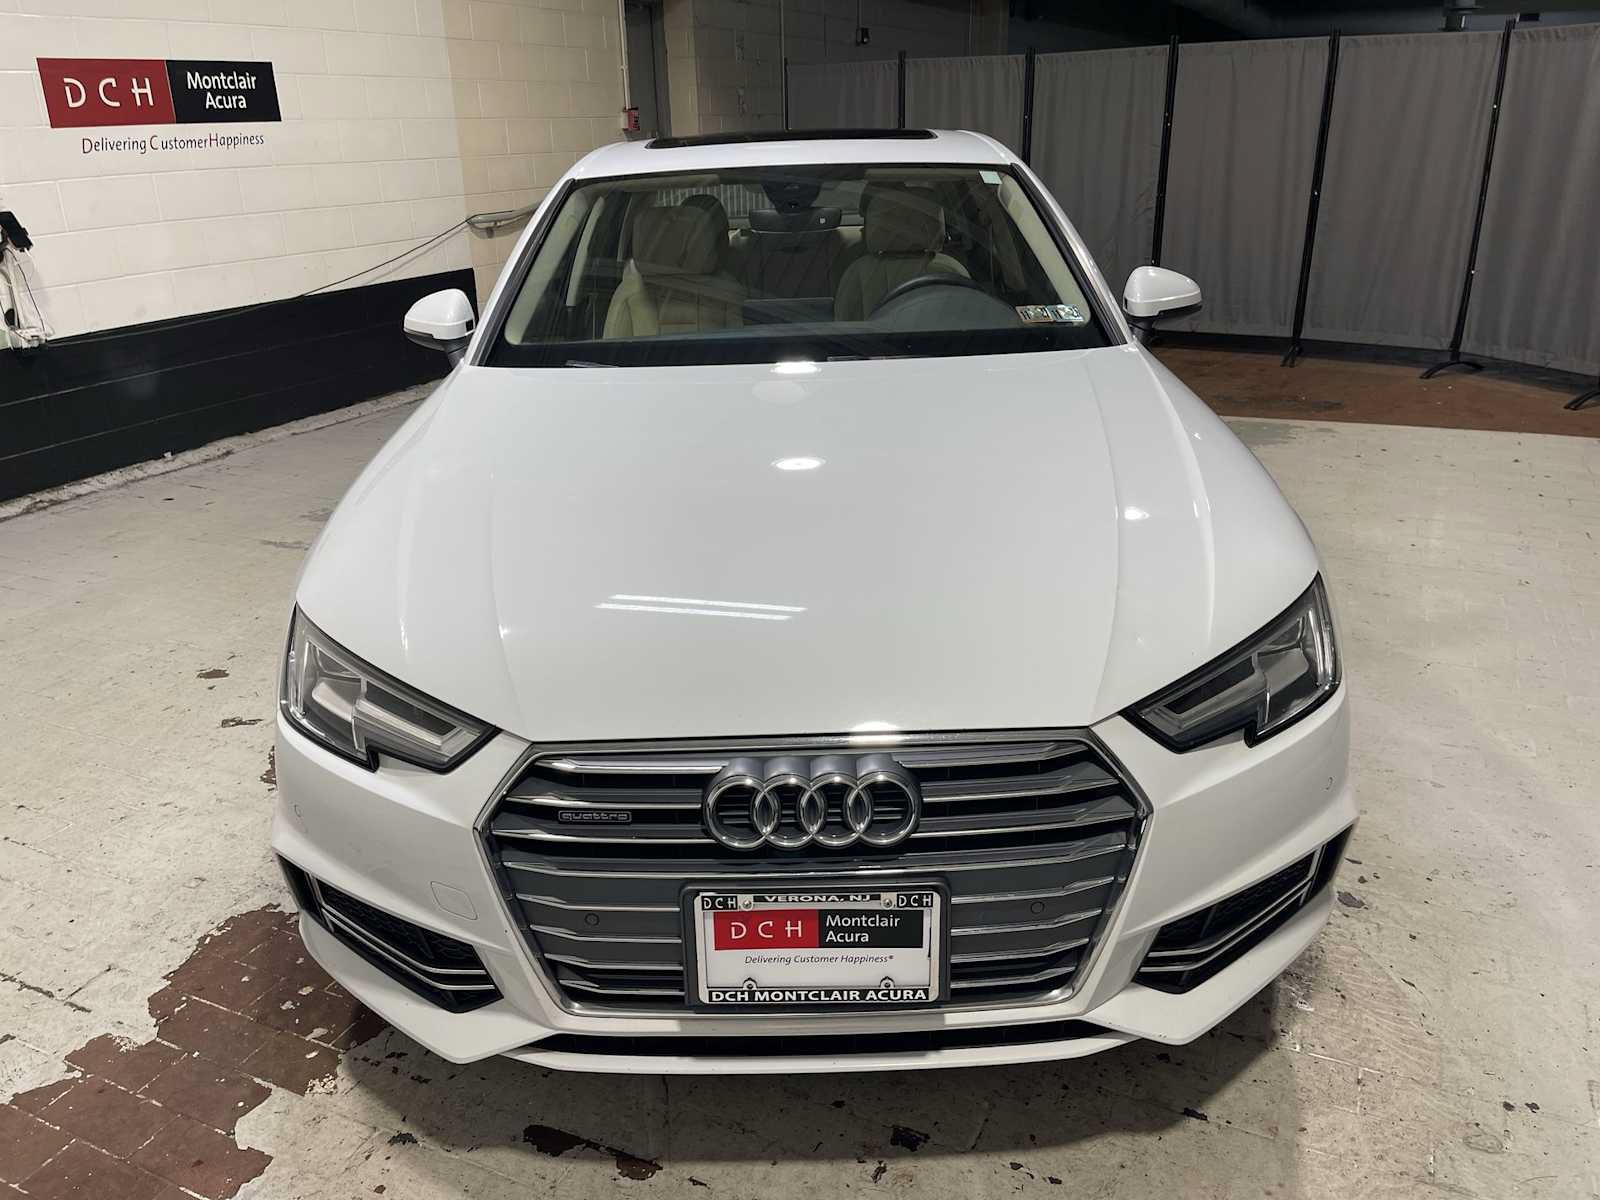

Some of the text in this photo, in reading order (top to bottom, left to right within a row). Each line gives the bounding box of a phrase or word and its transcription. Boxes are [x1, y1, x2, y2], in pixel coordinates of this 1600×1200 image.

[186, 71, 257, 90] Montclair
[205, 92, 247, 109] Acura
[82, 137, 147, 154] Delivering
[562, 812, 628, 821] quattro
[703, 897, 737, 909] DCH
[764, 894, 871, 902] VERONA, NJ
[898, 895, 932, 907] DCH
[826, 914, 900, 927] Montclair
[731, 920, 802, 939] DCH
[825, 930, 869, 943] Acura
[745, 955, 791, 965] Delivering
[794, 955, 838, 963] Customer
[711, 988, 927, 1001] DCH MONTCLAIR ACURA
